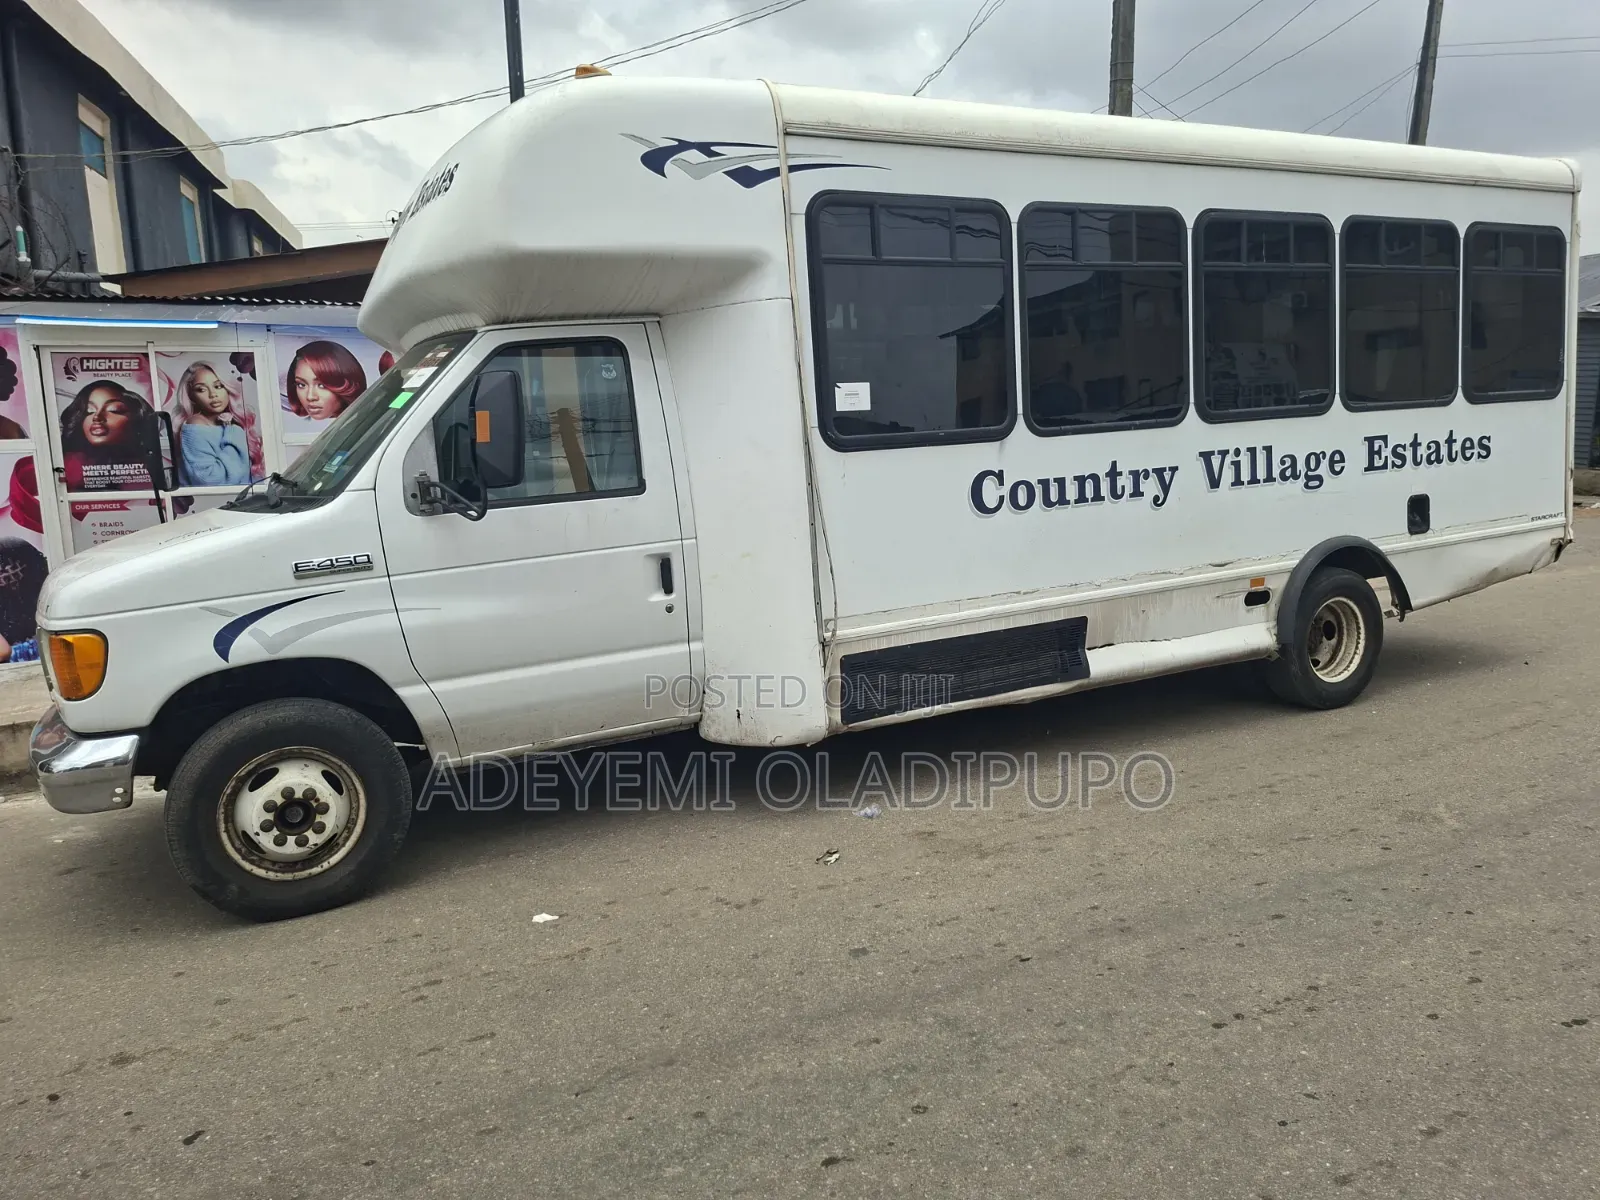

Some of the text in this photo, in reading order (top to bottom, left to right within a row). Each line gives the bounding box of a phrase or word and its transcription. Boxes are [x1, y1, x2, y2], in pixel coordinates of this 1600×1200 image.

[83, 359, 139, 370] HIGHTEE
[969, 429, 1492, 516] Country Village Estates
[1530, 512, 1564, 522] STARCRAFT
